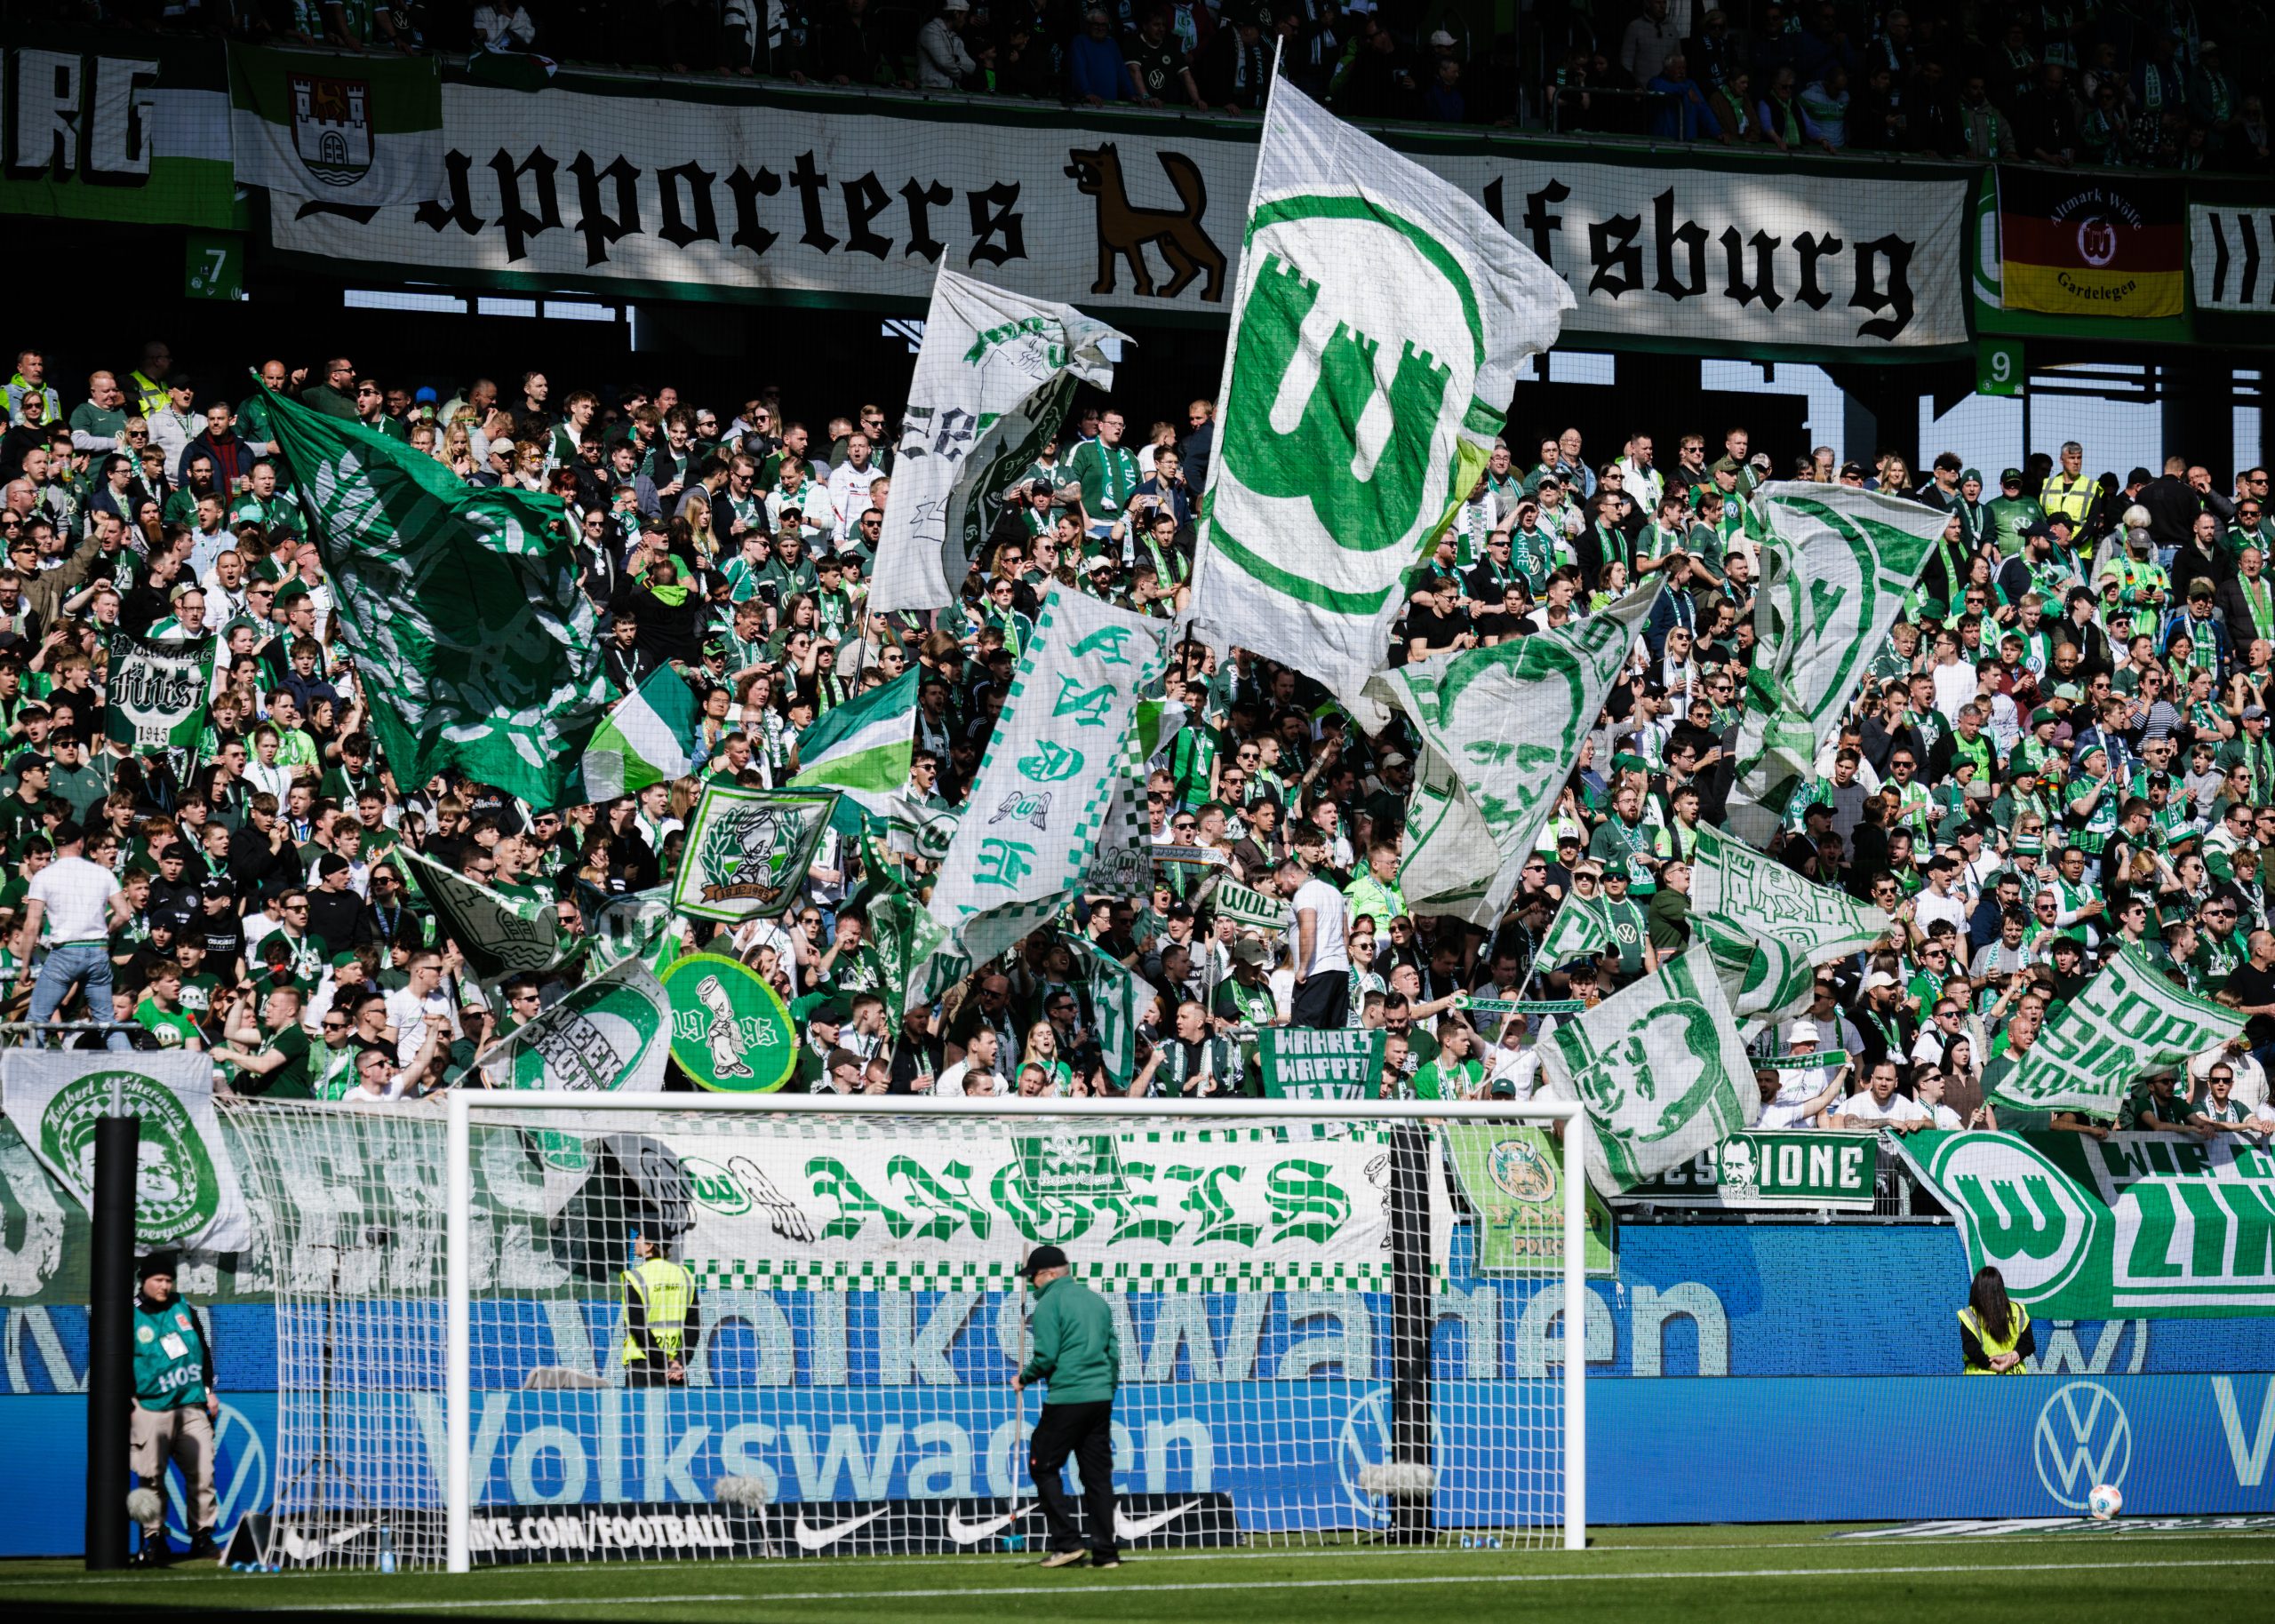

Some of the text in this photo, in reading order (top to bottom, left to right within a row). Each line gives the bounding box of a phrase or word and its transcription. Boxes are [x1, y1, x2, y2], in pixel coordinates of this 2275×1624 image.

[0, 47, 161, 175] RG
[2049, 187, 2145, 232] Altmark Wölfe
[296, 144, 1916, 342] upporters lfsburg
[205, 250, 227, 283] 7
[2057, 272, 2137, 300] Gardelegen
[1992, 351, 2010, 381] 9
[138, 726, 169, 743] 1945
[1273, 1029, 1373, 1055] WAHRES
[2098, 1141, 2217, 1178] WIR
[543, 1281, 1728, 1387] Volkwagen
